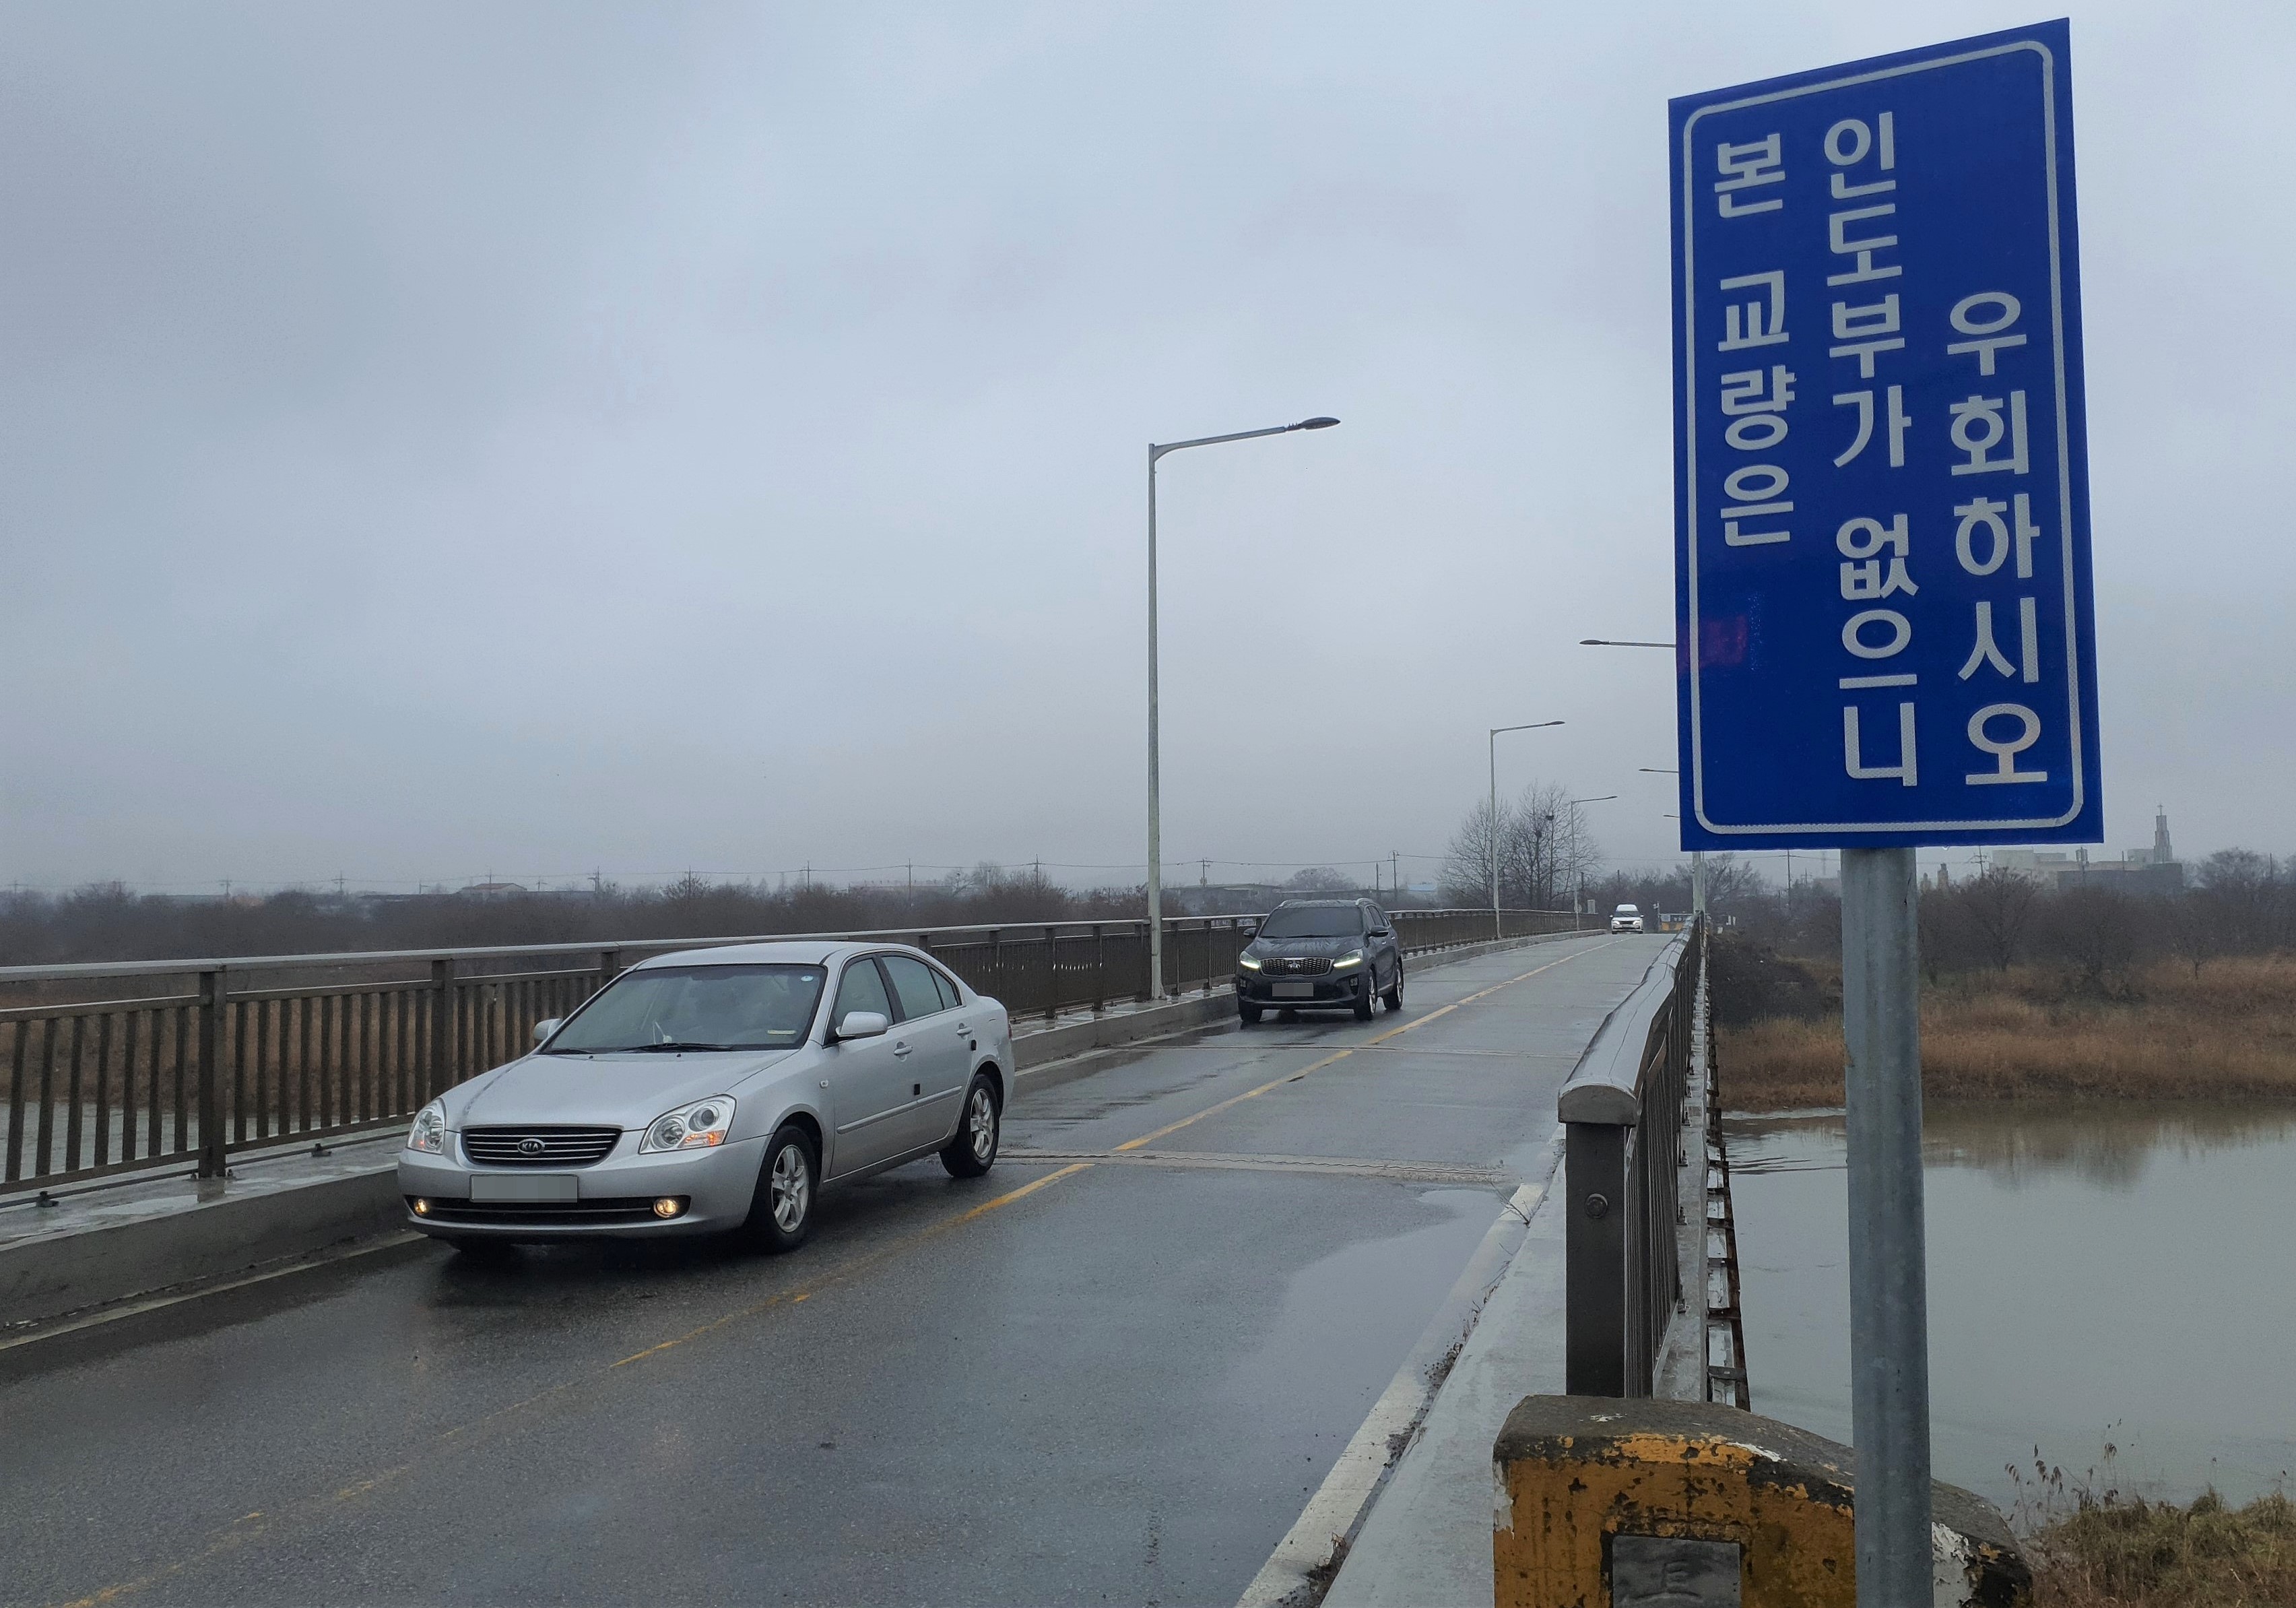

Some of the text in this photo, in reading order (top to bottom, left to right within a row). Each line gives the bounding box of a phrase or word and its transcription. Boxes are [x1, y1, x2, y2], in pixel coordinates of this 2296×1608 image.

[1715, 133, 1796, 546] 본 교량은
[1825, 112, 1918, 787] 인도부가 없으니
[1947, 292, 2047, 785] 우회하시오
[522, 1143, 539, 1151] KIA
